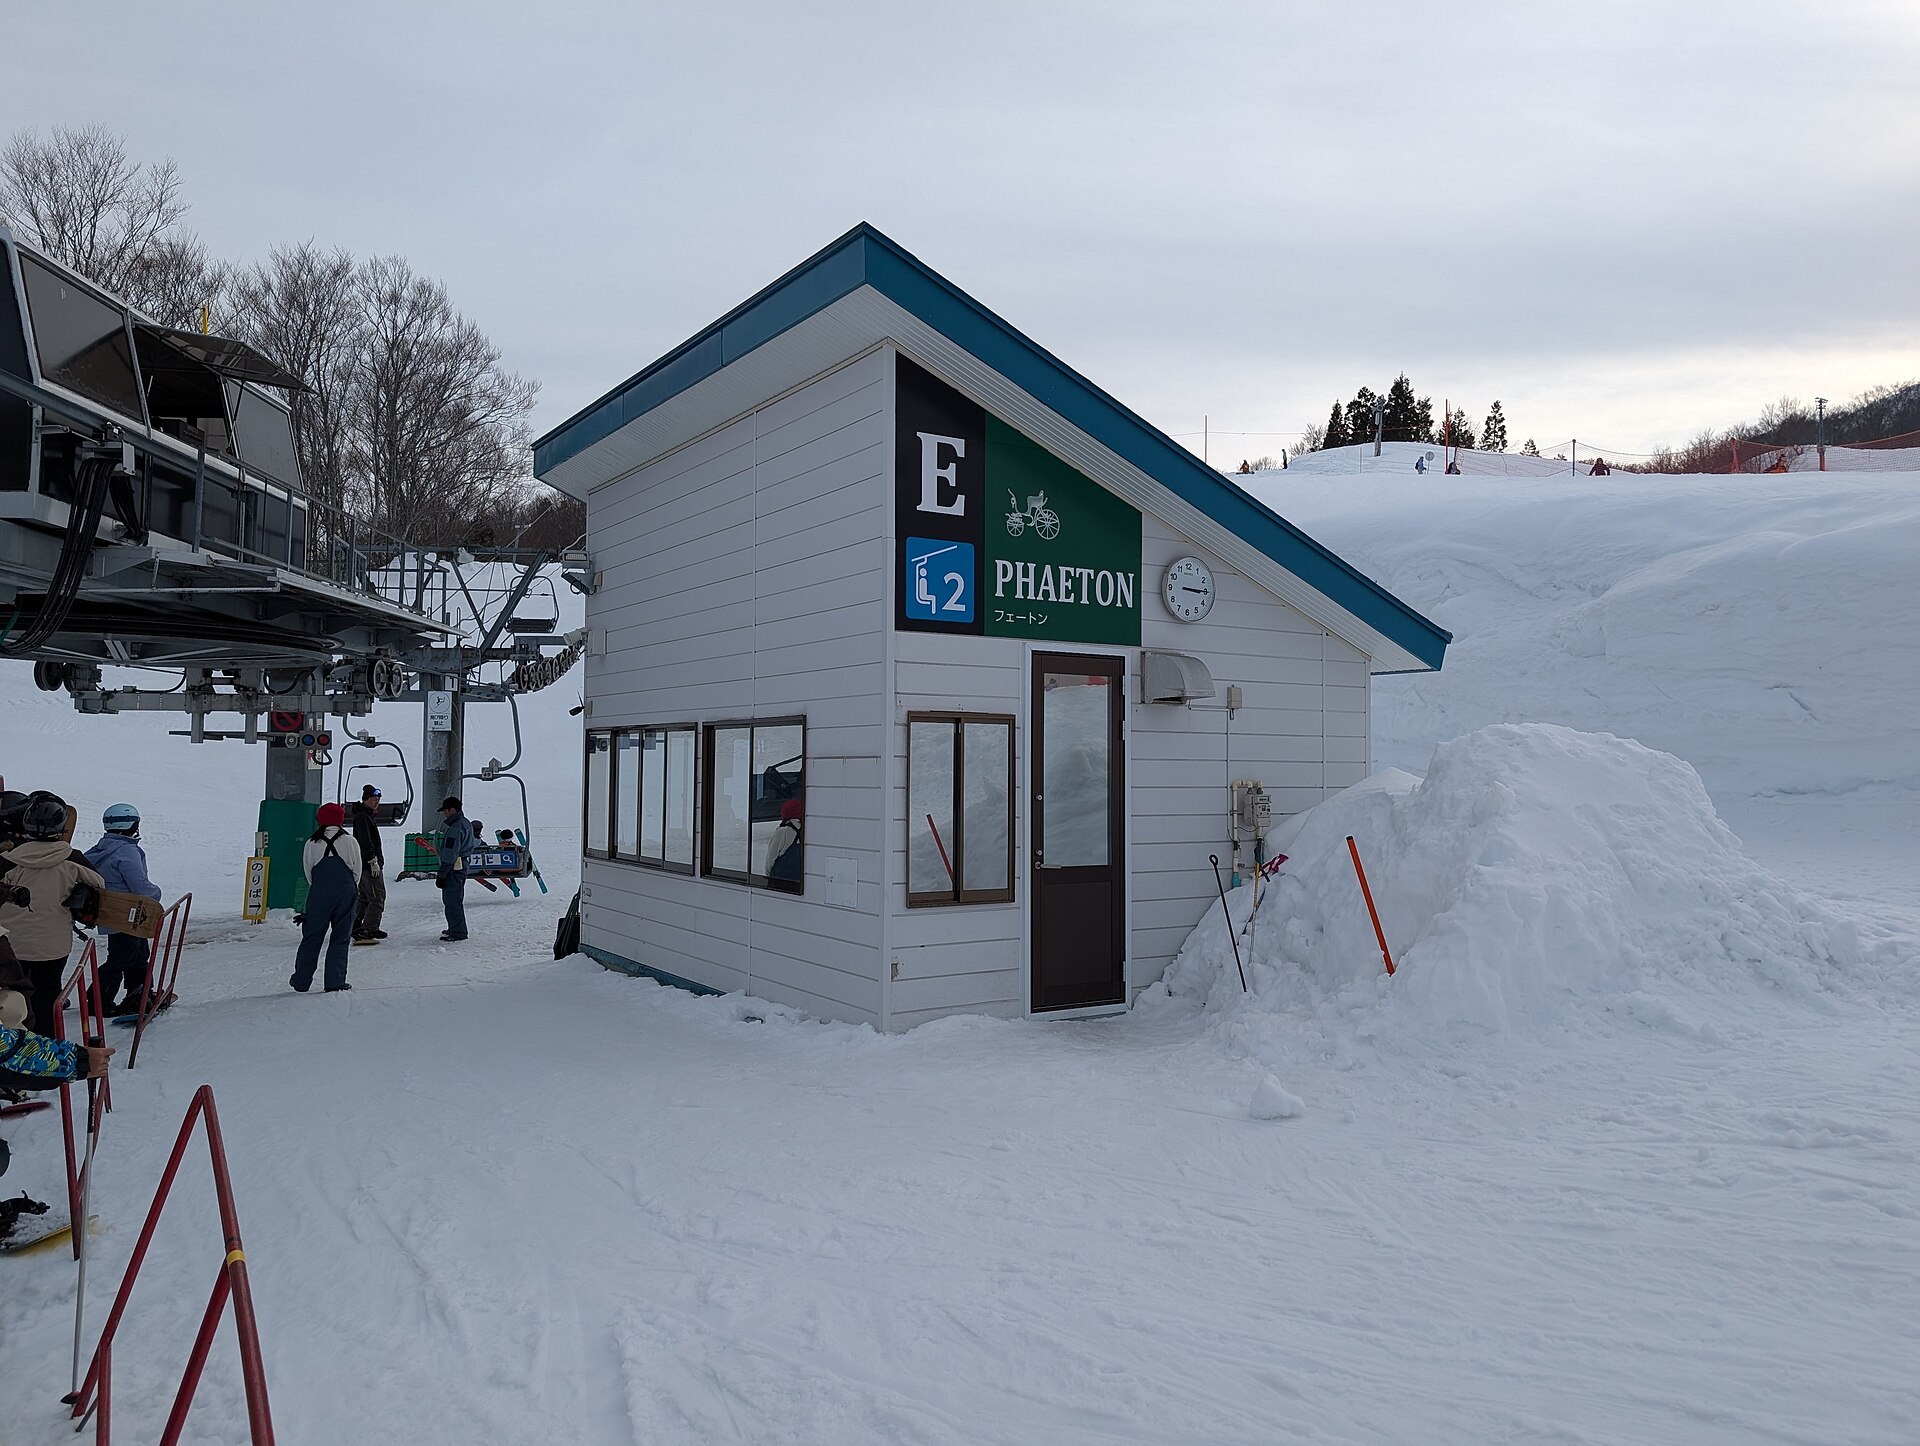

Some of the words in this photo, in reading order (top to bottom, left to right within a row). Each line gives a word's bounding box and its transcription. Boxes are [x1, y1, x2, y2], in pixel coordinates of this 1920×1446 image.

[916, 431, 966, 517] E
[942, 572, 966, 612] 2
[994, 559, 1135, 608] PHAETON
[994, 610, 1048, 625] フェートン
[249, 862, 263, 898] のりば
